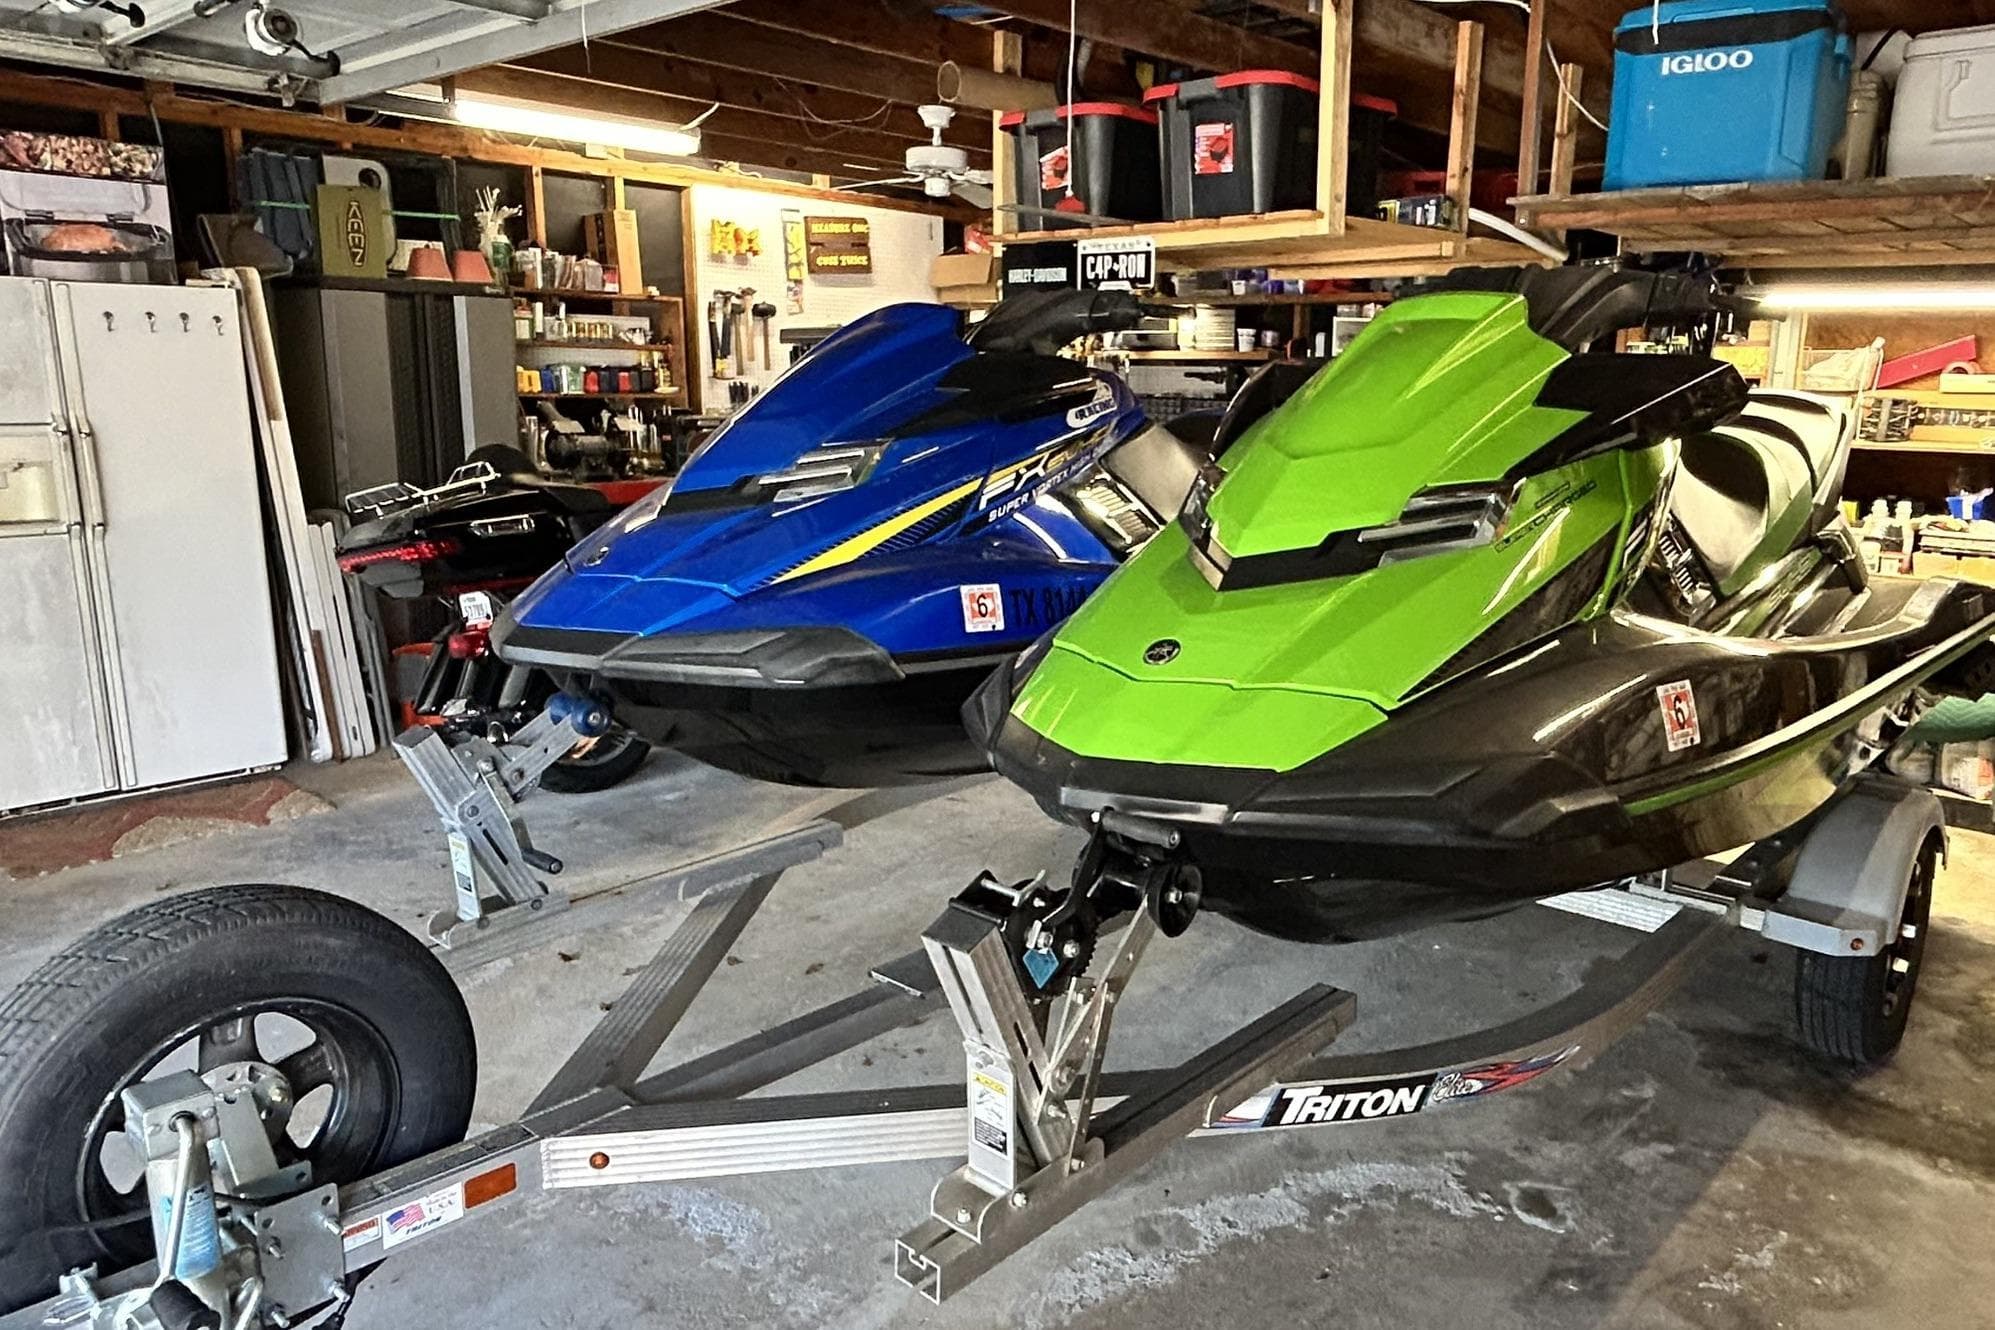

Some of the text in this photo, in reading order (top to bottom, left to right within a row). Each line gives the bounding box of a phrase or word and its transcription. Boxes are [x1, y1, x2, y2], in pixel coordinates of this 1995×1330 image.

[1661, 50, 1753, 75] IGLOO
[347, 201, 365, 266] KEEN
[988, 492, 1030, 523] SUPER
[976, 593, 988, 618] 6
[1009, 587, 1034, 626] TX
[1673, 695, 1686, 730] 6
[1280, 1085, 1426, 1125] TRITON
